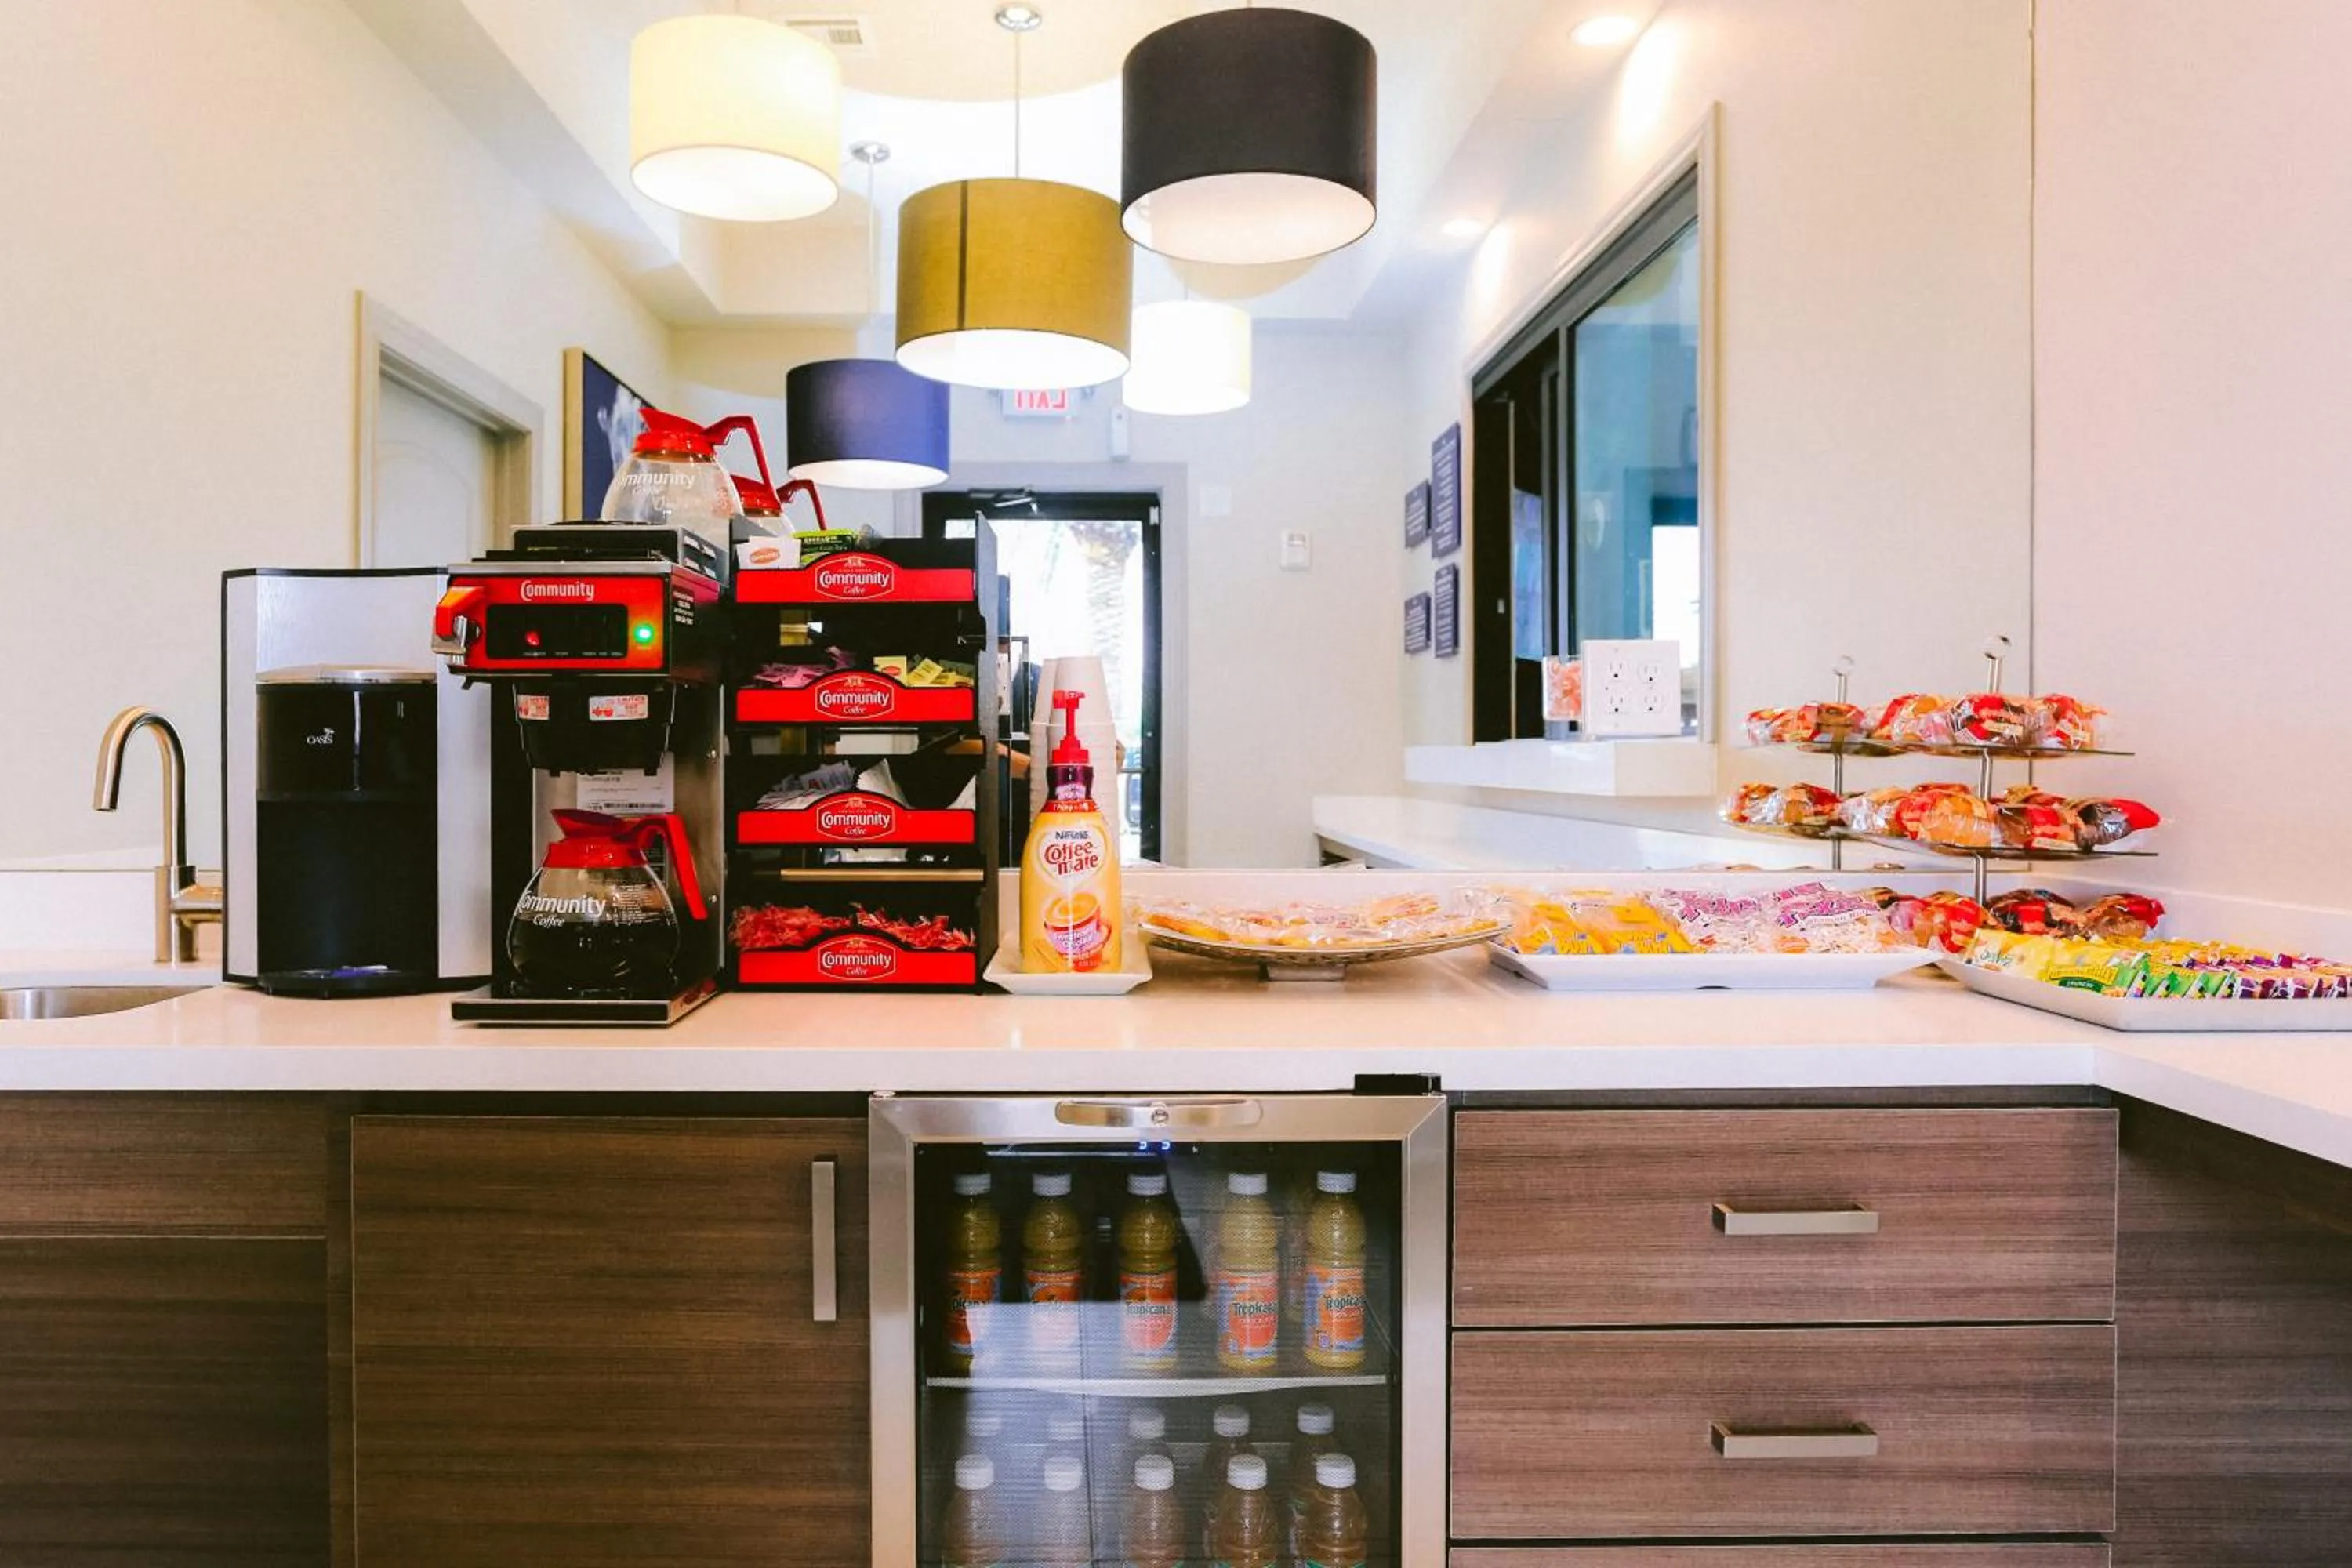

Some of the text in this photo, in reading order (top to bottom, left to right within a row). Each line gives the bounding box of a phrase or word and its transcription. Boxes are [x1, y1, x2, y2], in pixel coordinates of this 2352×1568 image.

[819, 571, 890, 588] Community
[520, 579, 595, 601] Community
[843, 586, 866, 595] Coffee
[819, 689, 890, 706] Community
[843, 706, 866, 714] Coffee
[821, 811, 891, 829] Community
[844, 827, 866, 836] Coffee
[1044, 842, 1094, 865] Coffee
[1058, 854, 1098, 876] mate
[516, 889, 607, 917] Community
[533, 914, 565, 929] Coffee
[822, 951, 891, 969] Community
[845, 967, 868, 976] Coffee
